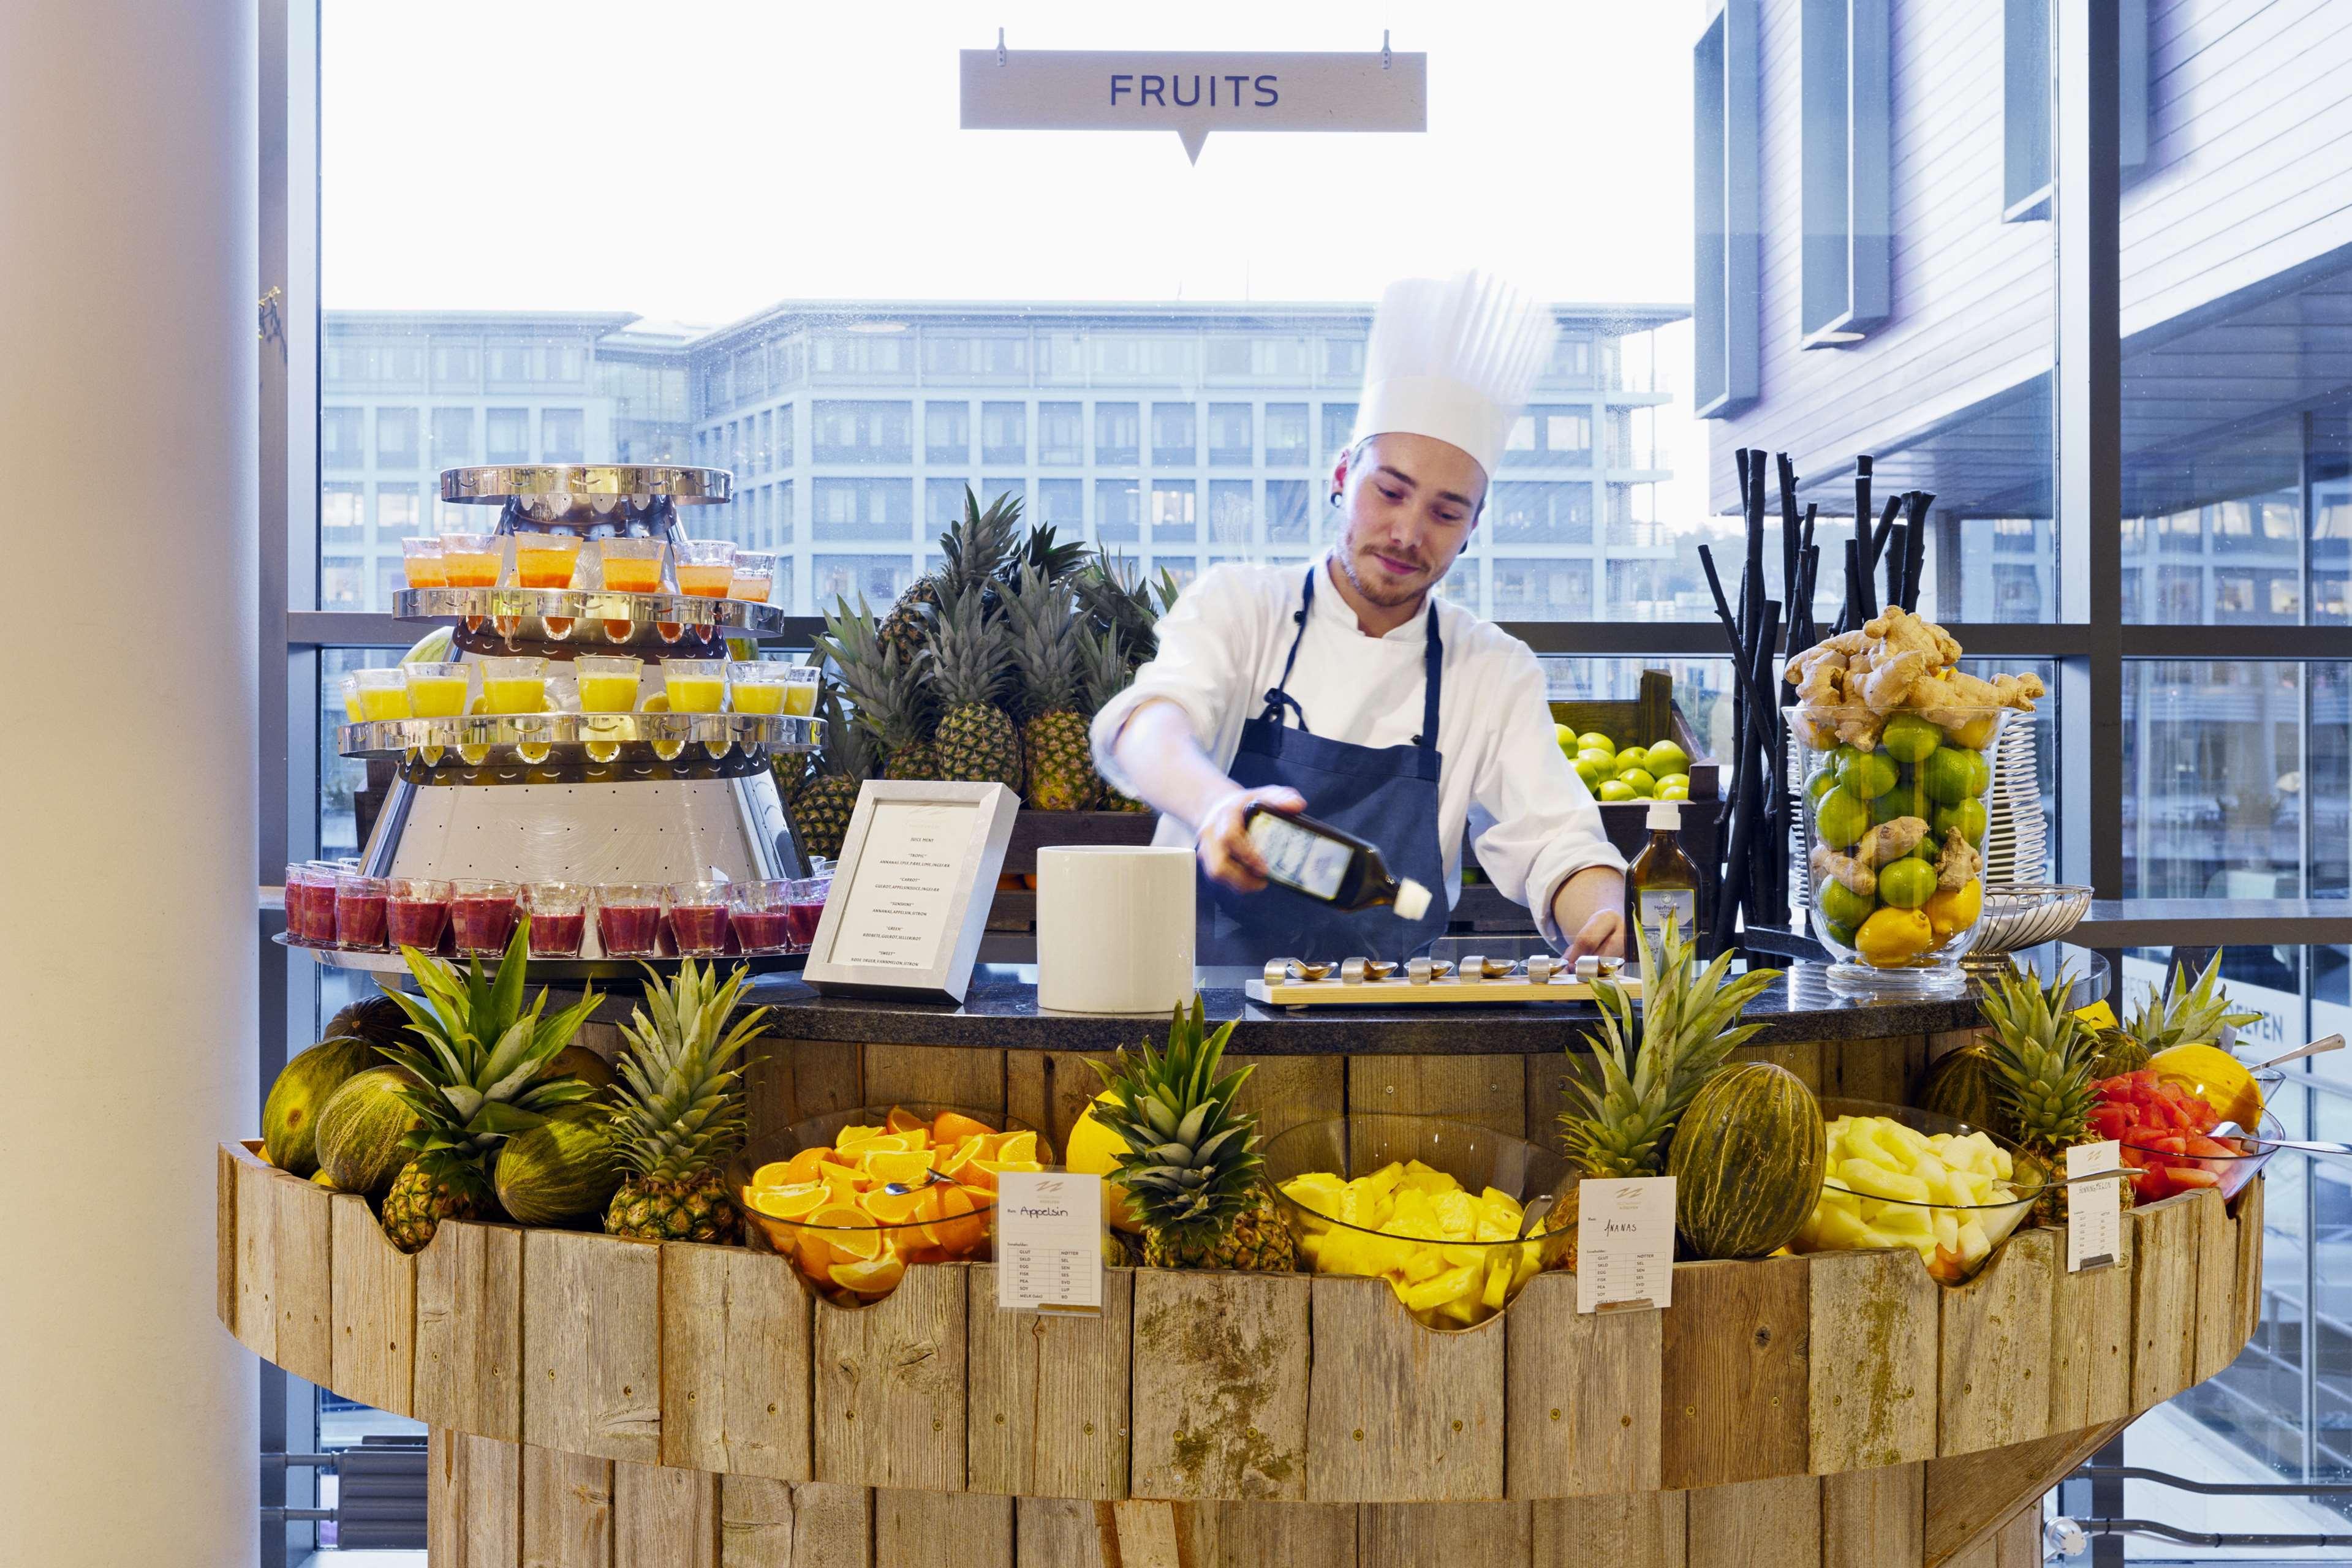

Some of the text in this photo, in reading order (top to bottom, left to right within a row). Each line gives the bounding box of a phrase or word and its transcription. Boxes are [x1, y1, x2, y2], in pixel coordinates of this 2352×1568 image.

[1110, 75, 1280, 107] FRUITS
[1020, 1205, 1068, 1218] Appelsin
[1604, 1219, 1637, 1237] ANANAS
